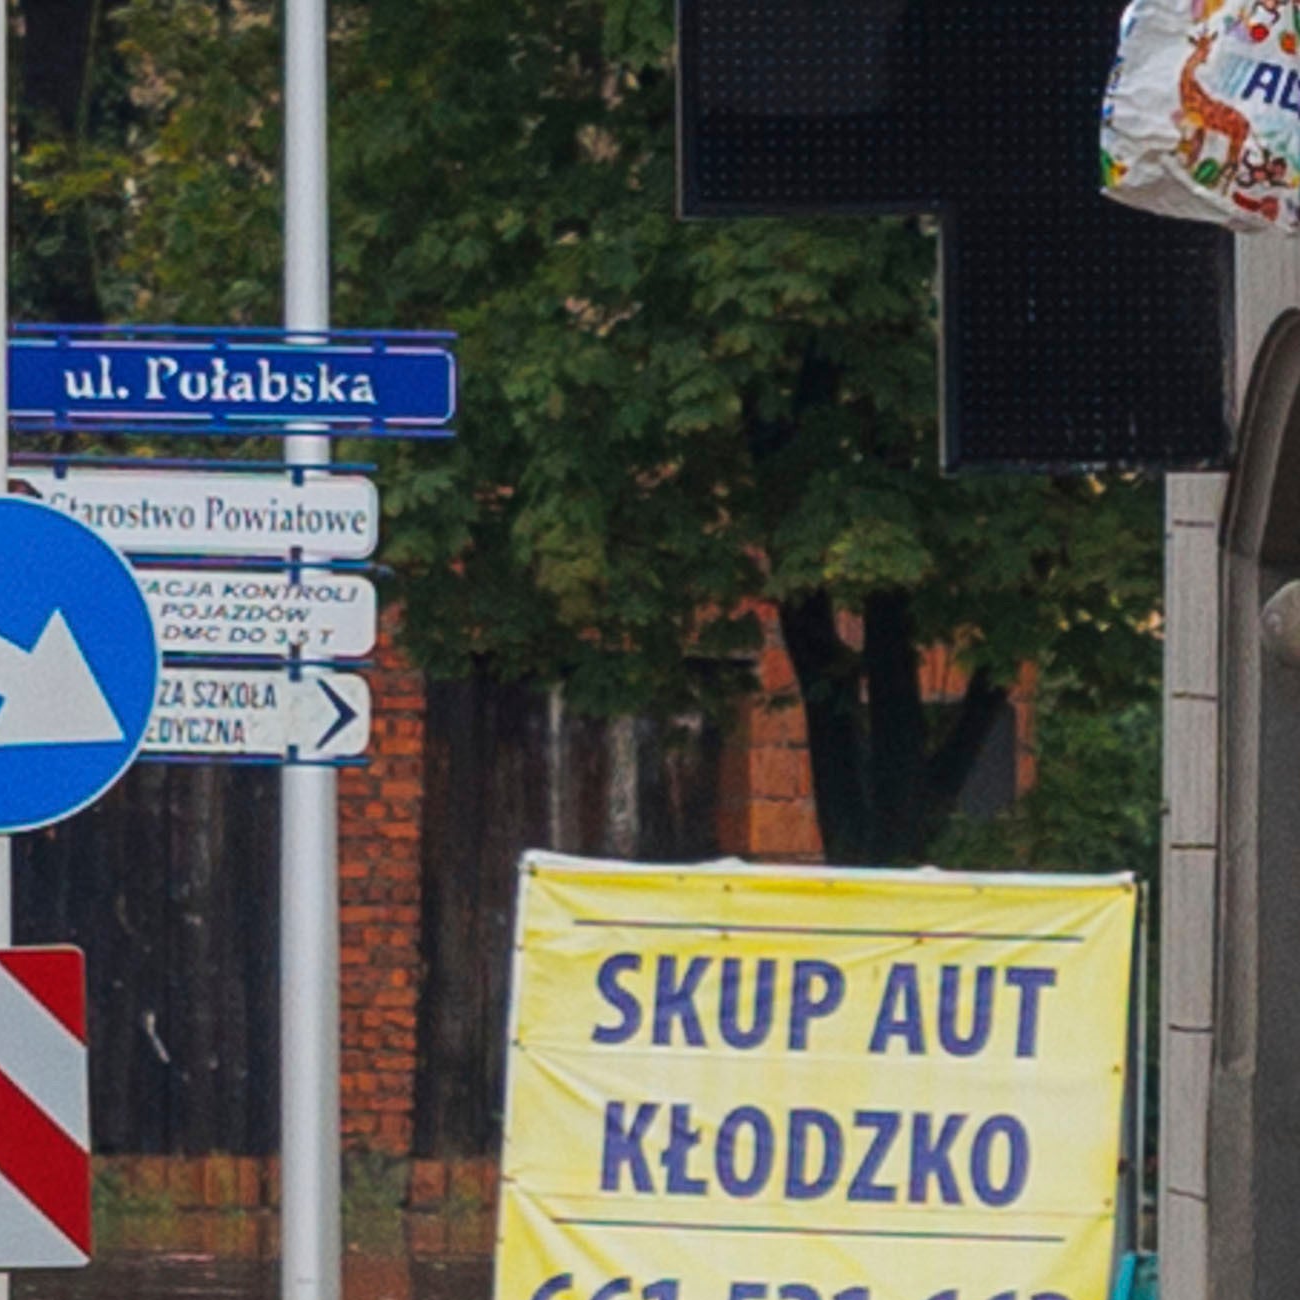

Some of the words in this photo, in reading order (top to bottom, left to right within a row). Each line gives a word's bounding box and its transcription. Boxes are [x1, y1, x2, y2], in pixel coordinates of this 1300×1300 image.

[63, 354, 130, 400] ul.
[144, 356, 379, 405] Połabska
[204, 496, 367, 535] Powiatowe
[143, 578, 214, 599] ACJA
[222, 582, 359, 603] KONTROLI
[162, 624, 222, 643] DMC
[228, 626, 267, 644] DO
[319, 628, 335, 645] T
[193, 680, 277, 709] SZKOŁA
[591, 951, 847, 1051] SKUP
[868, 962, 1057, 1059] AUT
[599, 1099, 1030, 1209] KŁODZKO
